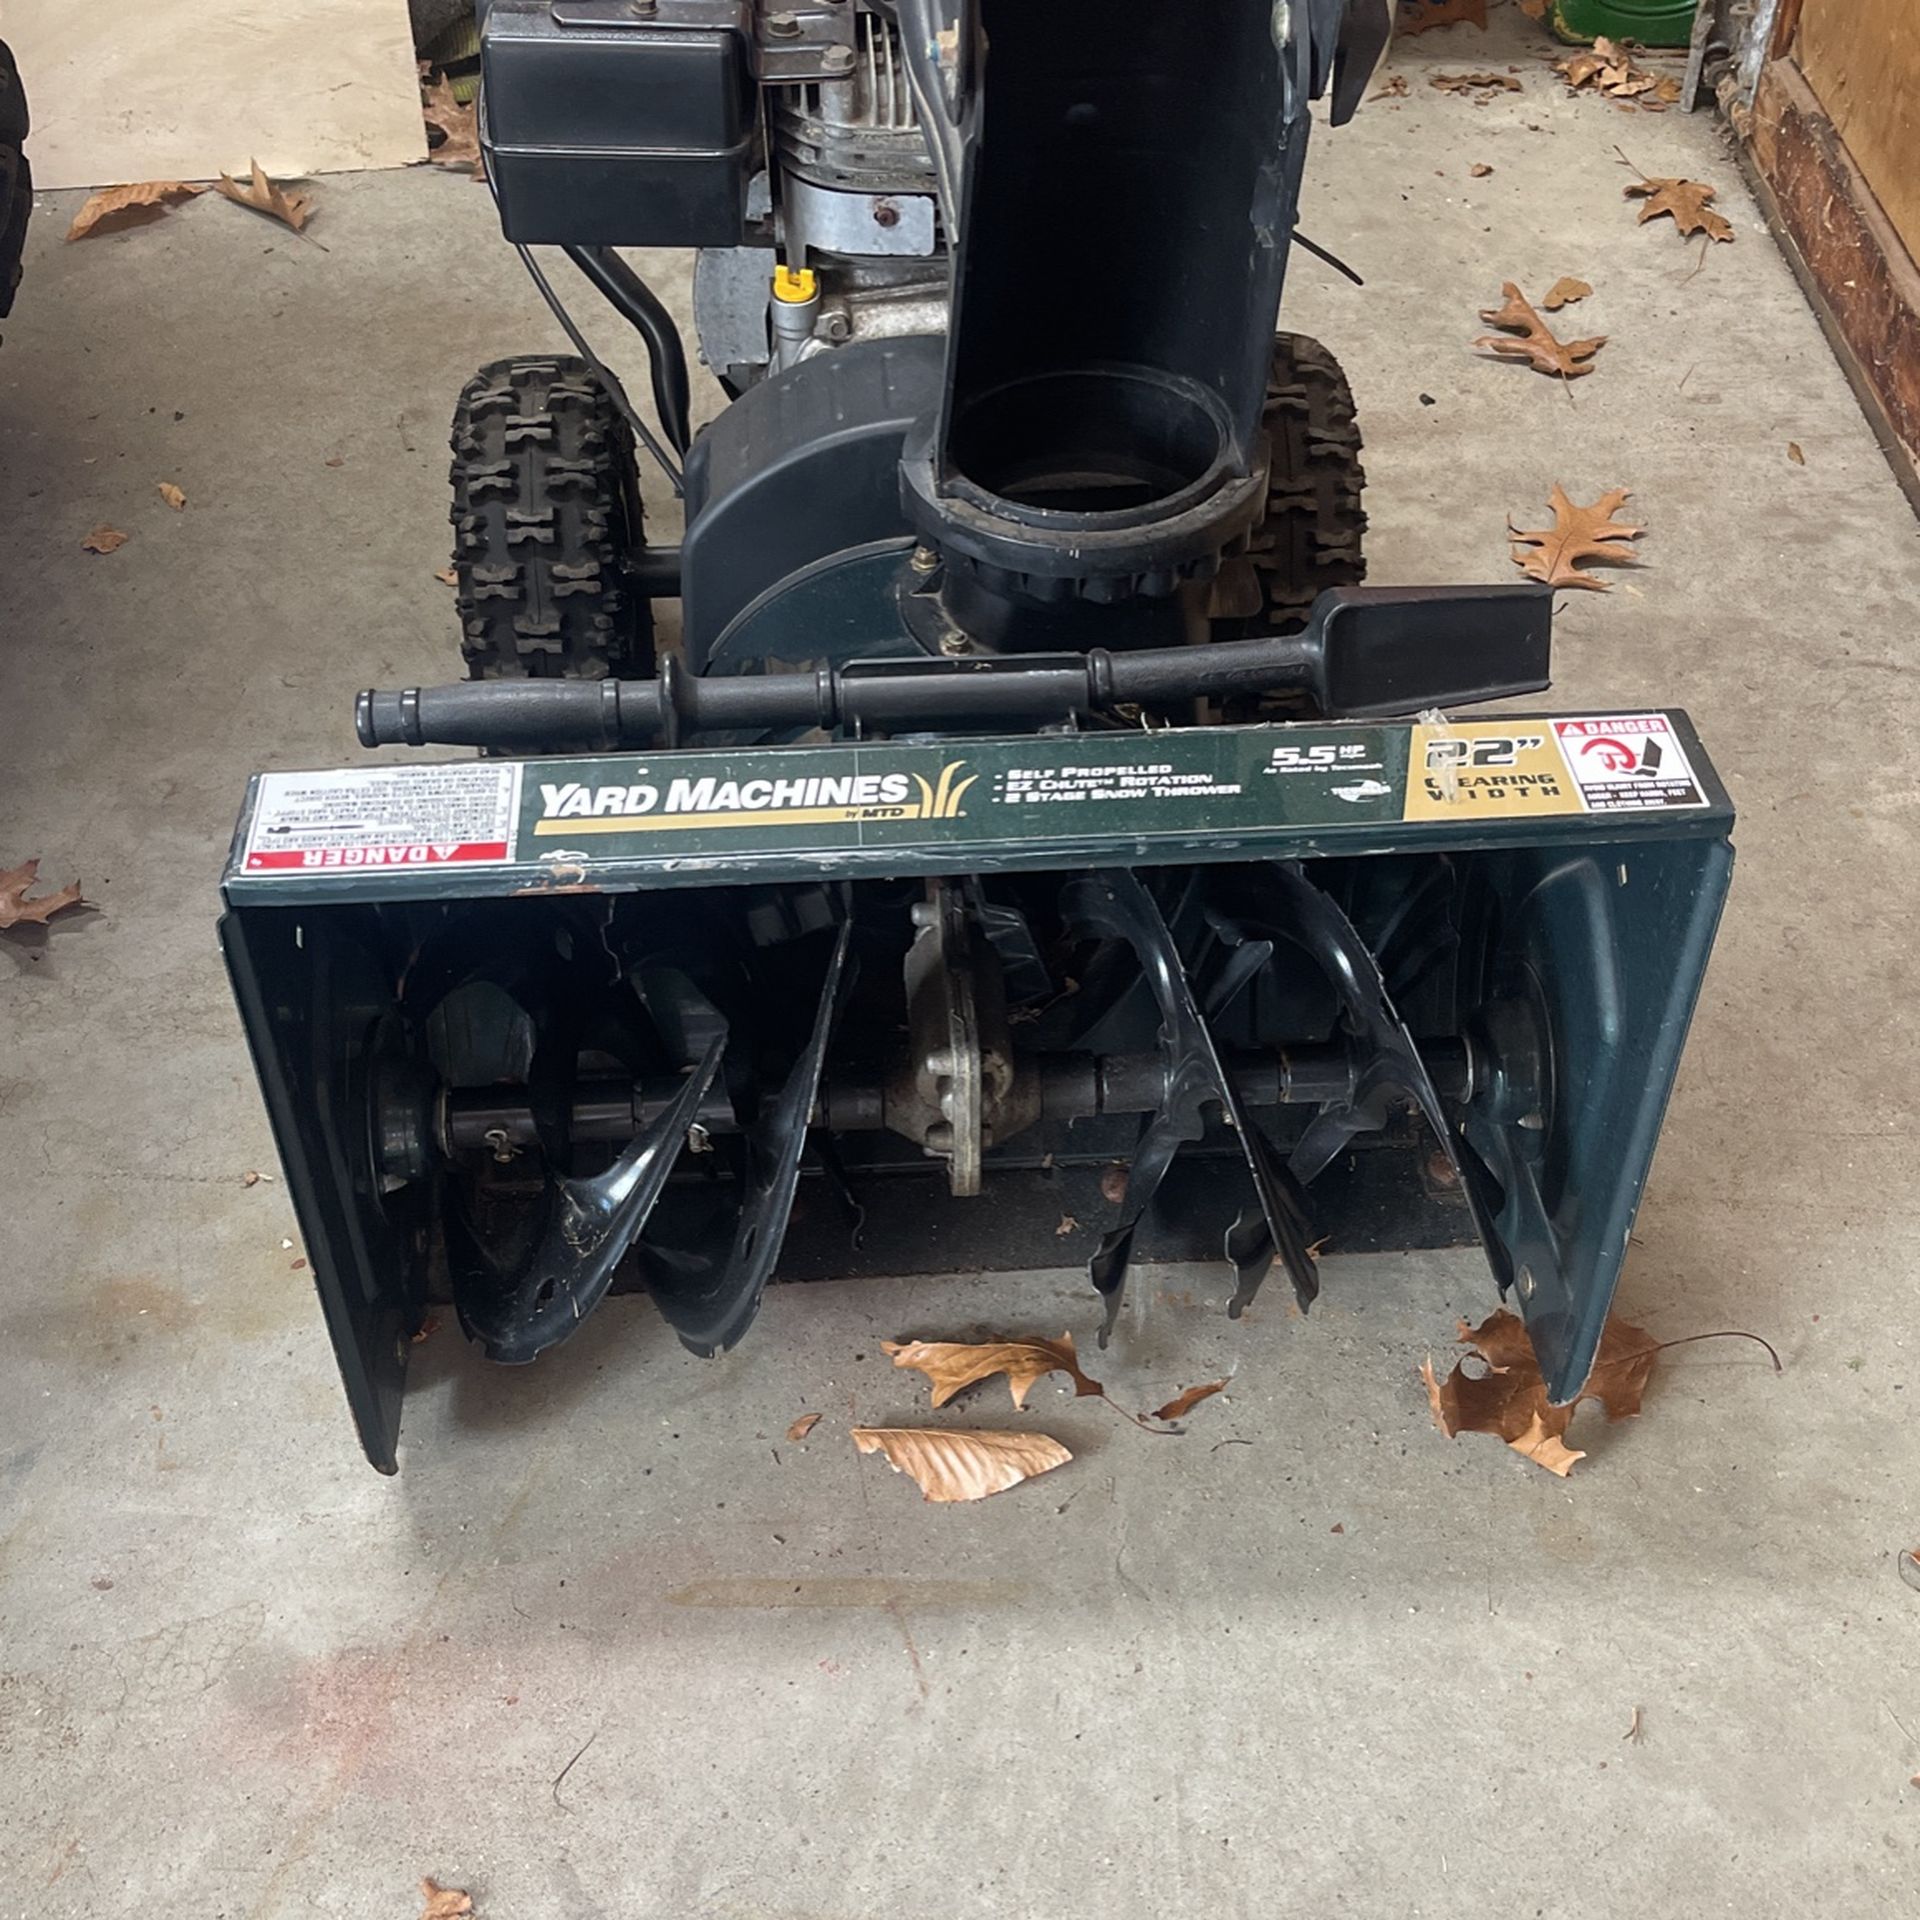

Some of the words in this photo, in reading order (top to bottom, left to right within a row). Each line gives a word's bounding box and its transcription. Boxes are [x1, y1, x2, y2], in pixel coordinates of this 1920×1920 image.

[1584, 720, 1664, 734] DANGER
[1272, 745, 1336, 766] 5.5
[1007, 767, 1057, 780] SELF
[1061, 764, 1173, 778] PROPELLED
[1424, 773, 1556, 788] CEARING
[1006, 780, 1033, 792] EZ
[1120, 774, 1213, 786] ROTATION
[539, 782, 657, 817] YARD
[664, 773, 908, 813] MACHINES
[1026, 789, 1086, 802] STAGE
[1092, 787, 1148, 800] SNOW
[1152, 784, 1242, 798] THROWER
[845, 808, 858, 819] by
[862, 806, 905, 818] MTD
[303, 847, 432, 866] DANGER
